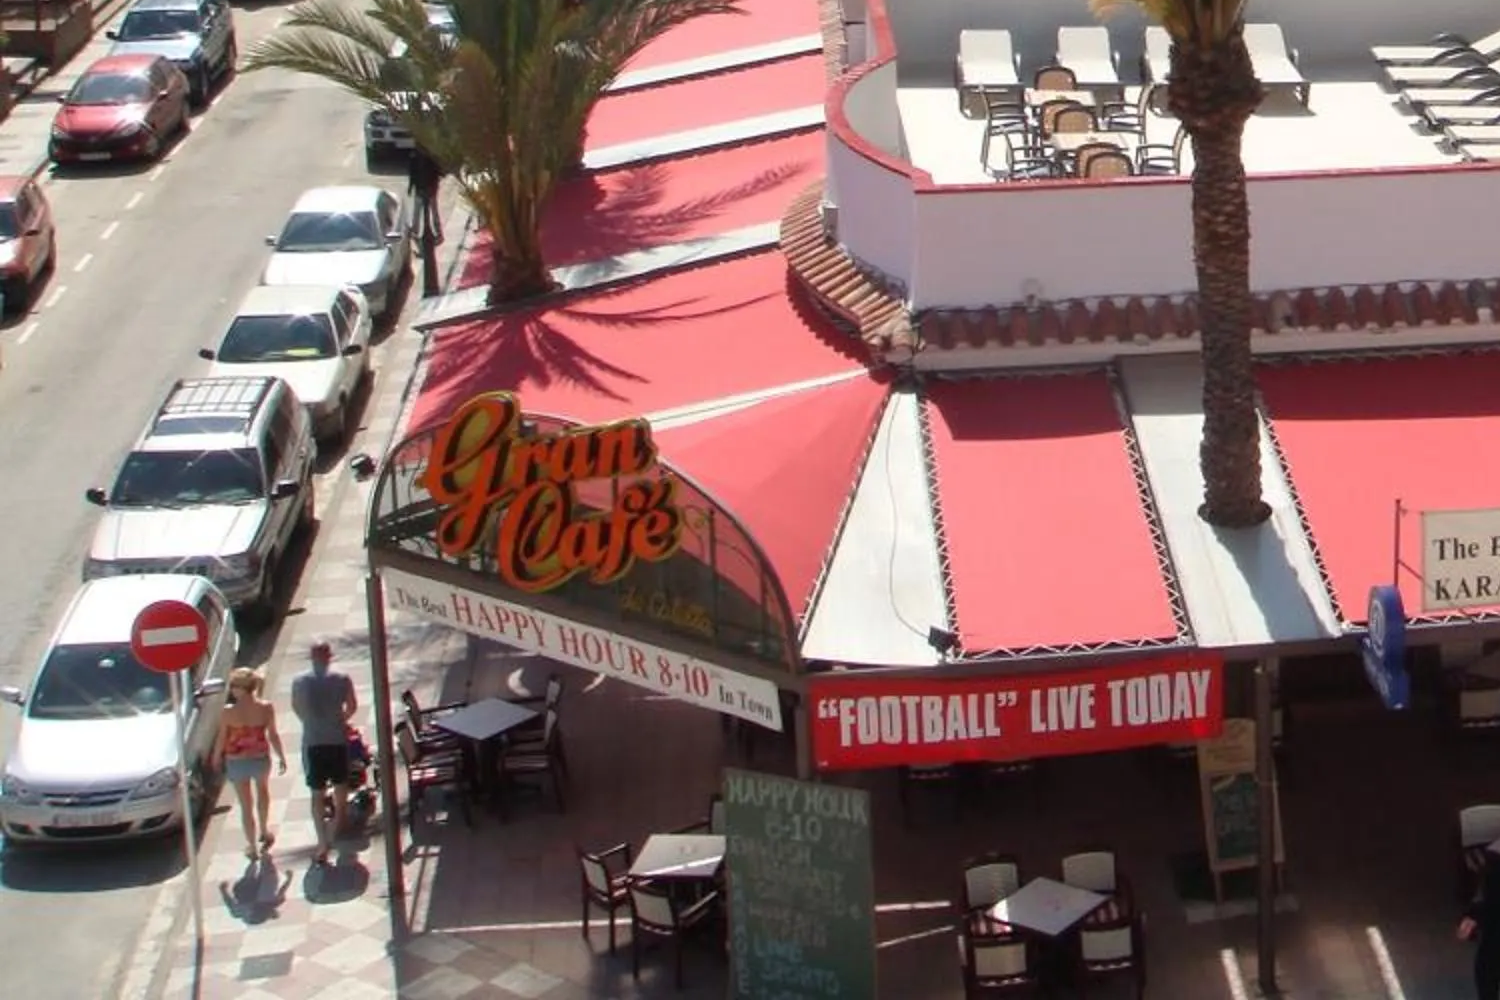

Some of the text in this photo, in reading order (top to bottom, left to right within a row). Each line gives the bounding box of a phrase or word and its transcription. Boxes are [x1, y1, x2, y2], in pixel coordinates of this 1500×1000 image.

[416, 391, 657, 554] Gran
[497, 473, 681, 592] Café
[1432, 538, 1480, 561] The
[421, 596, 447, 617] Best
[451, 593, 545, 647] HAPPY
[558, 625, 648, 680] HOUR
[719, 685, 732, 704] In
[739, 690, 773, 721] Town
[1030, 684, 1096, 733] LIVE
[1107, 670, 1211, 727] TODAY
[727, 775, 868, 826] HAPPY HOUR
